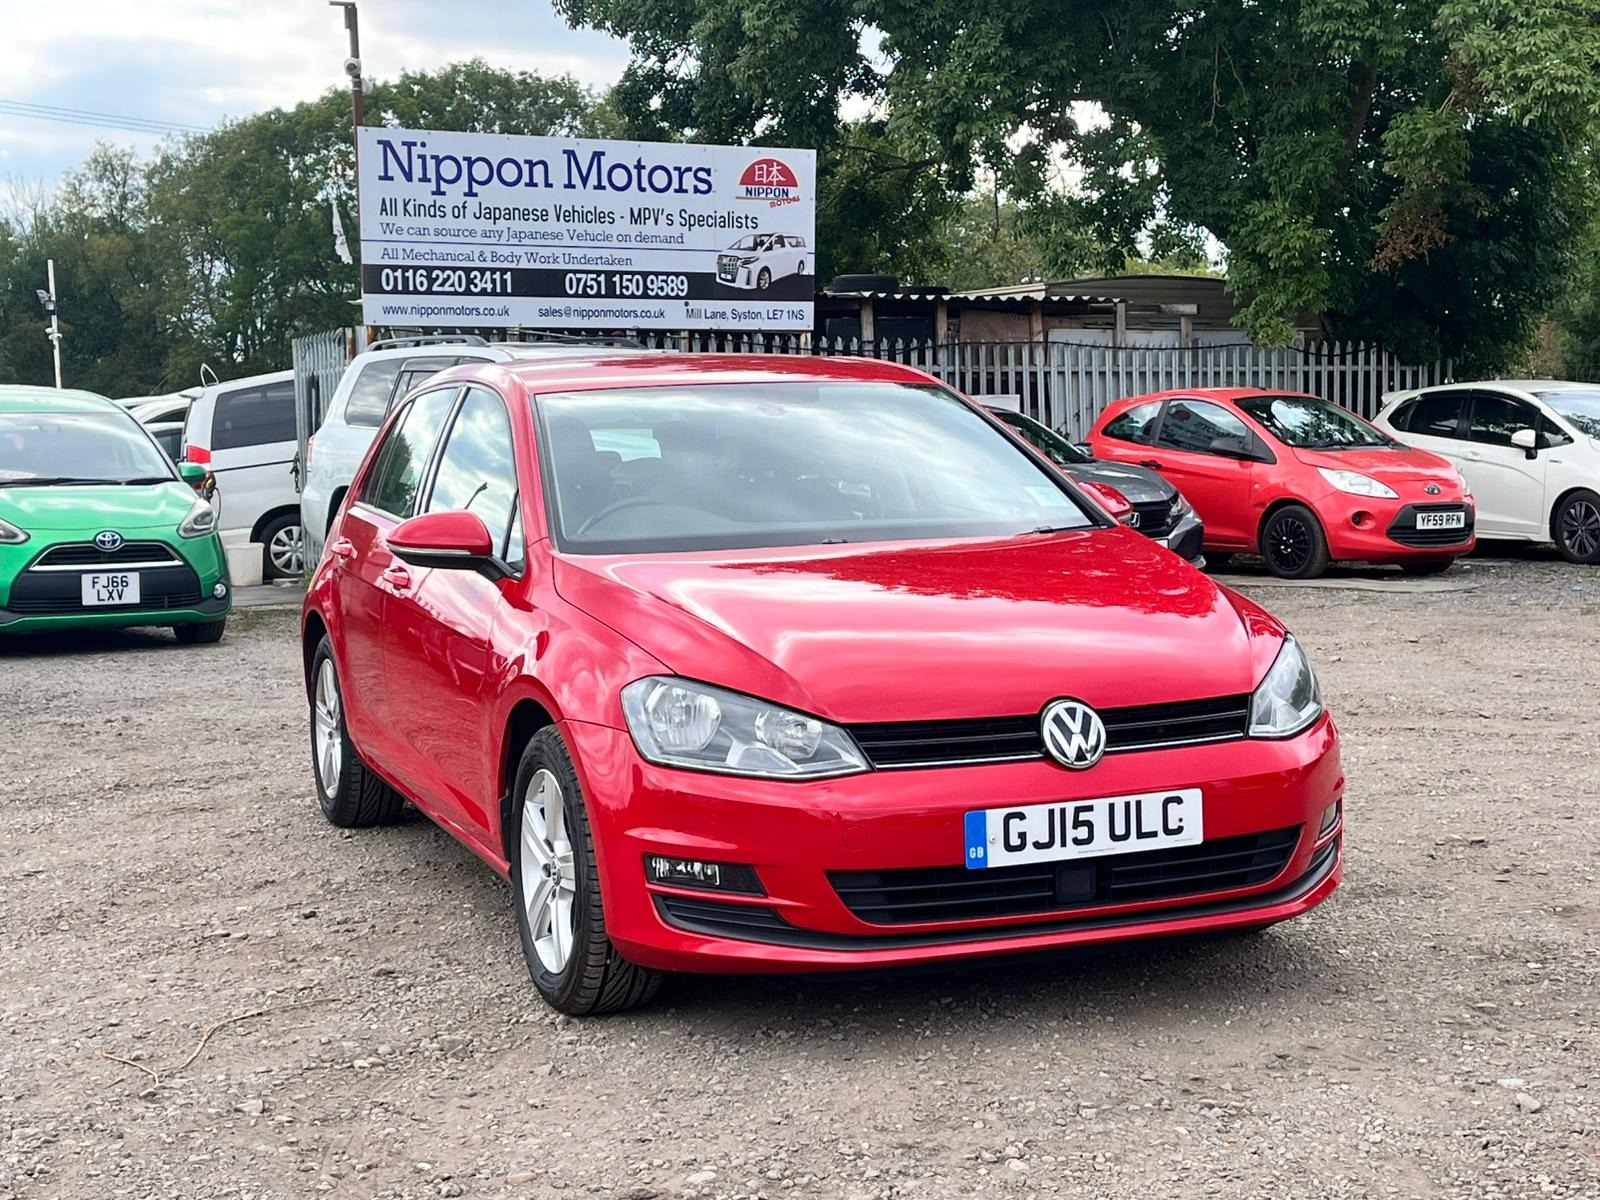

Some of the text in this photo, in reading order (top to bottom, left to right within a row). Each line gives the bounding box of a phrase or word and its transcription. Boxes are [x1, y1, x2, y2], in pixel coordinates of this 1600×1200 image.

[376, 139, 713, 198] Nippon Motors
[754, 161, 787, 186] 日本
[745, 186, 789, 198] NIPPON
[380, 197, 398, 216] All
[403, 198, 447, 218] Kinds
[452, 200, 467, 219] of
[473, 201, 549, 225] Japanese
[554, 204, 615, 224] Vehicles
[629, 207, 674, 226] MPV's
[679, 208, 759, 231] Specialists
[380, 222, 685, 244] We can source any Japanese Vehicle on demand
[381, 247, 633, 267] All Mechanical & Body Work Undertaken
[381, 268, 512, 293] 0116 220 3411
[565, 272, 689, 297] 0751 150 9589
[382, 303, 510, 318] www.nipponmotors.co.uk
[538, 305, 666, 320] sales@nipponmotors.co.uk
[686, 307, 805, 322] Mill Lane, Syston, LE7 1NS
[1421, 513, 1462, 526] YF59 RFN
[91, 575, 129, 589] FJ66
[97, 588, 124, 601] LXV
[1003, 795, 1184, 853] GJ15 ULC
[969, 846, 984, 859] GB
